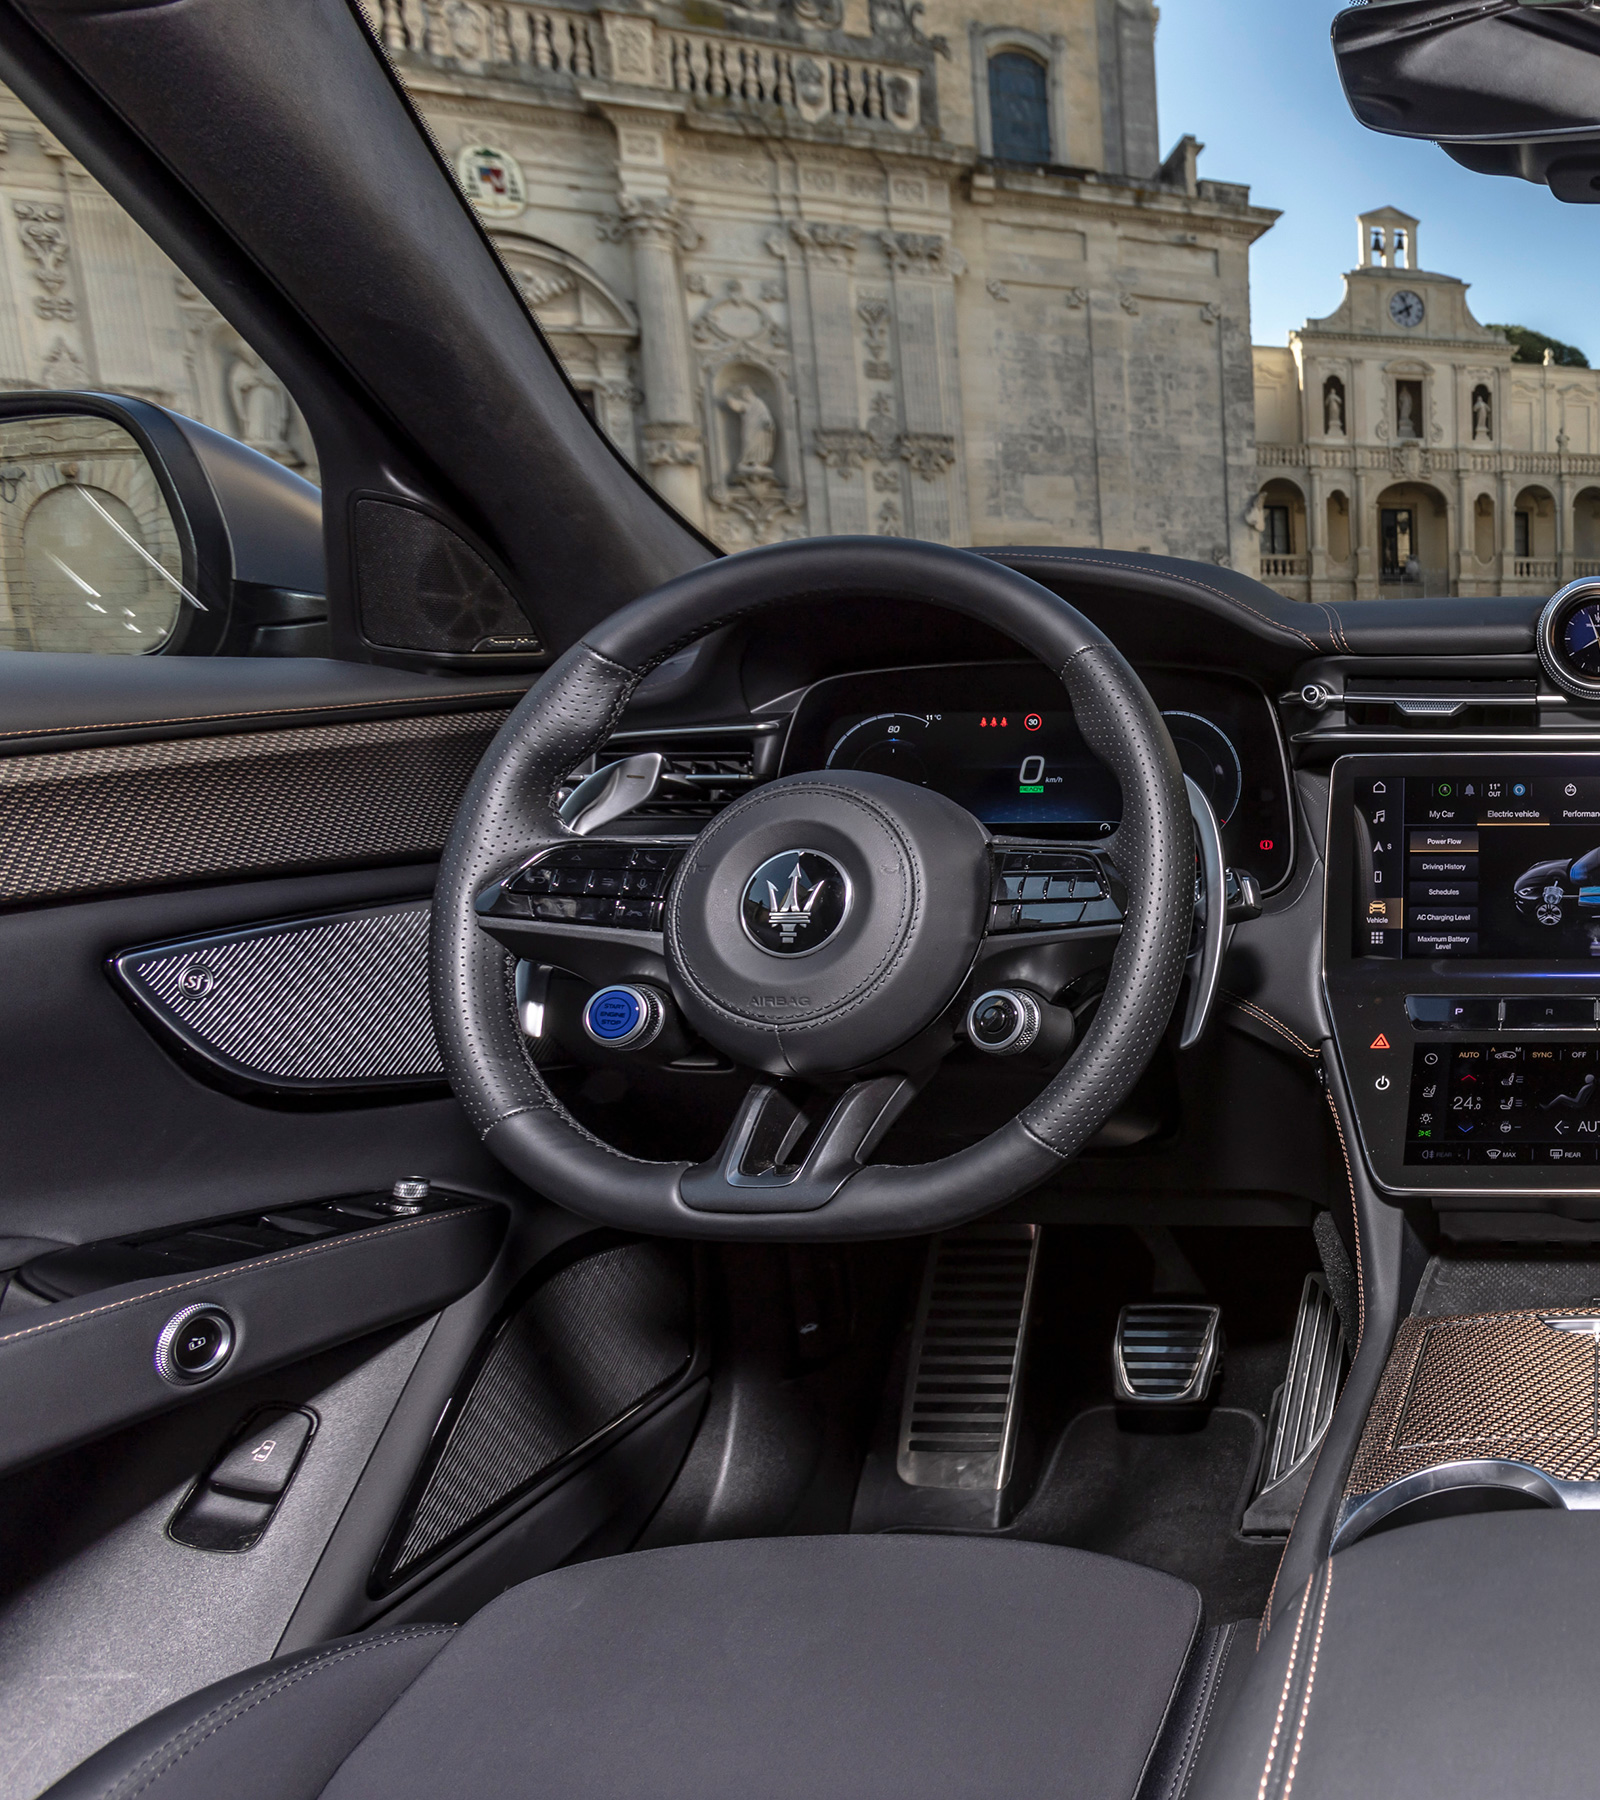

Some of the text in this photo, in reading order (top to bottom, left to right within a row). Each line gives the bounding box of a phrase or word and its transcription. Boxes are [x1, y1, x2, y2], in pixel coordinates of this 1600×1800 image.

[1028, 718, 1038, 726] 30
[887, 725, 900, 734] 80
[1019, 755, 1045, 784] 0
[1429, 811, 1441, 819] My
[1487, 810, 1540, 818] Electric vehicle
[1422, 863, 1466, 871] Driving History
[1426, 914, 1454, 922] Charging
[1447, 935, 1470, 944] Battery
[750, 995, 811, 1007] AIRBAG
[600, 1011, 626, 1019] ENGINE
[601, 1018, 622, 1026] STOP
[1458, 1051, 1480, 1059] AUTO
[1532, 1051, 1553, 1059] SYNC
[1571, 1051, 1587, 1059] OFF
